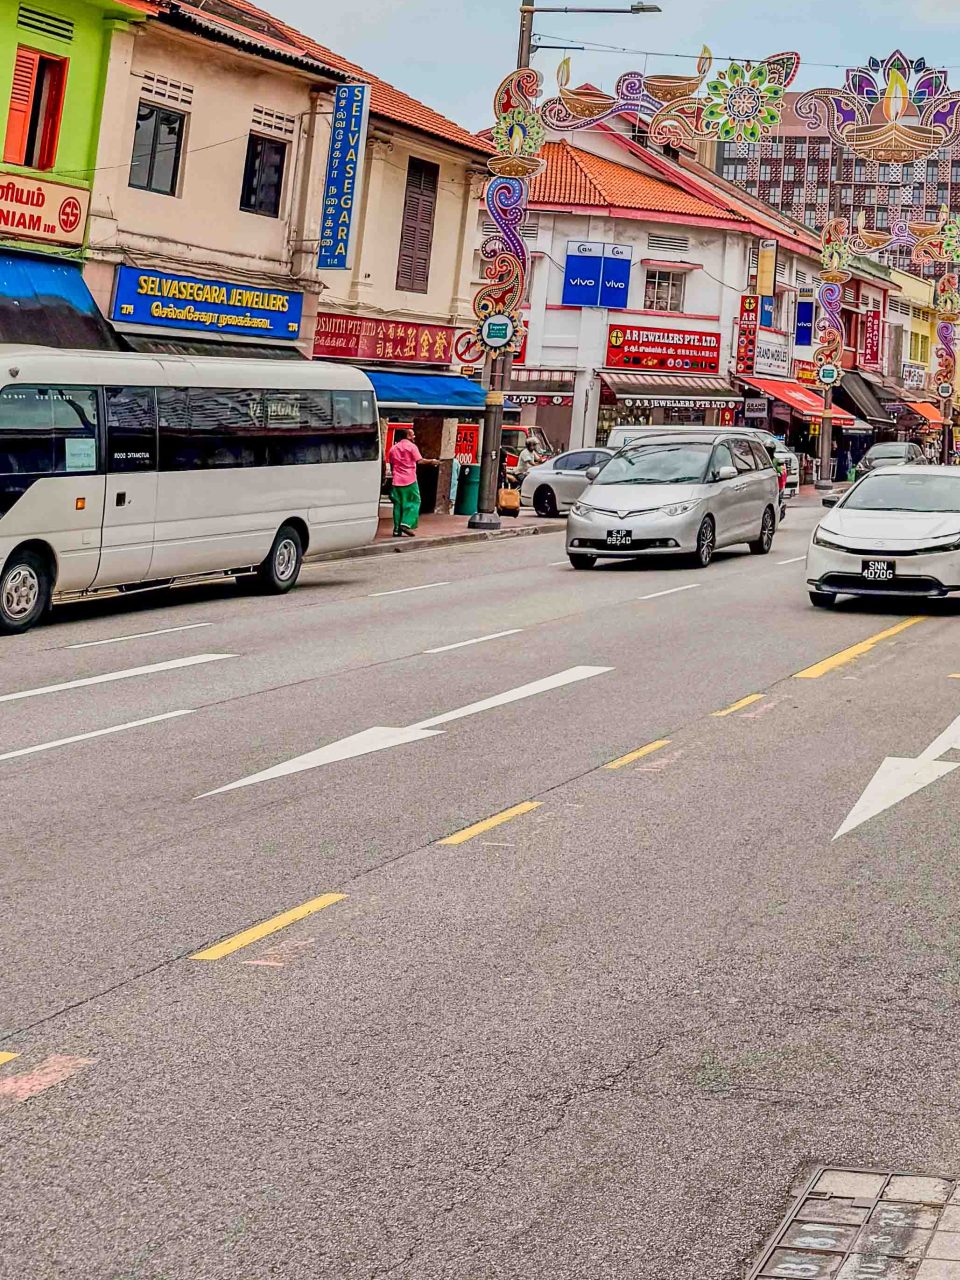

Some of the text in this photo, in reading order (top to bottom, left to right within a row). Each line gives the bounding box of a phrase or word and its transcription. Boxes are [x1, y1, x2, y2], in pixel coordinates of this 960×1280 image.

[335, 88, 363, 256] SELVASEGARA
[569, 277, 595, 286] vivo
[605, 280, 625, 288] vivo
[137, 275, 289, 312] SELVASEGARA JEWELLERS
[639, 331, 683, 345] JEWELLERS
[865, 311, 873, 359] NAKSHATRA
[650, 400, 694, 408] JEWELLERS
[869, 561, 887, 570] SNN
[862, 569, 893, 579] 4070G
